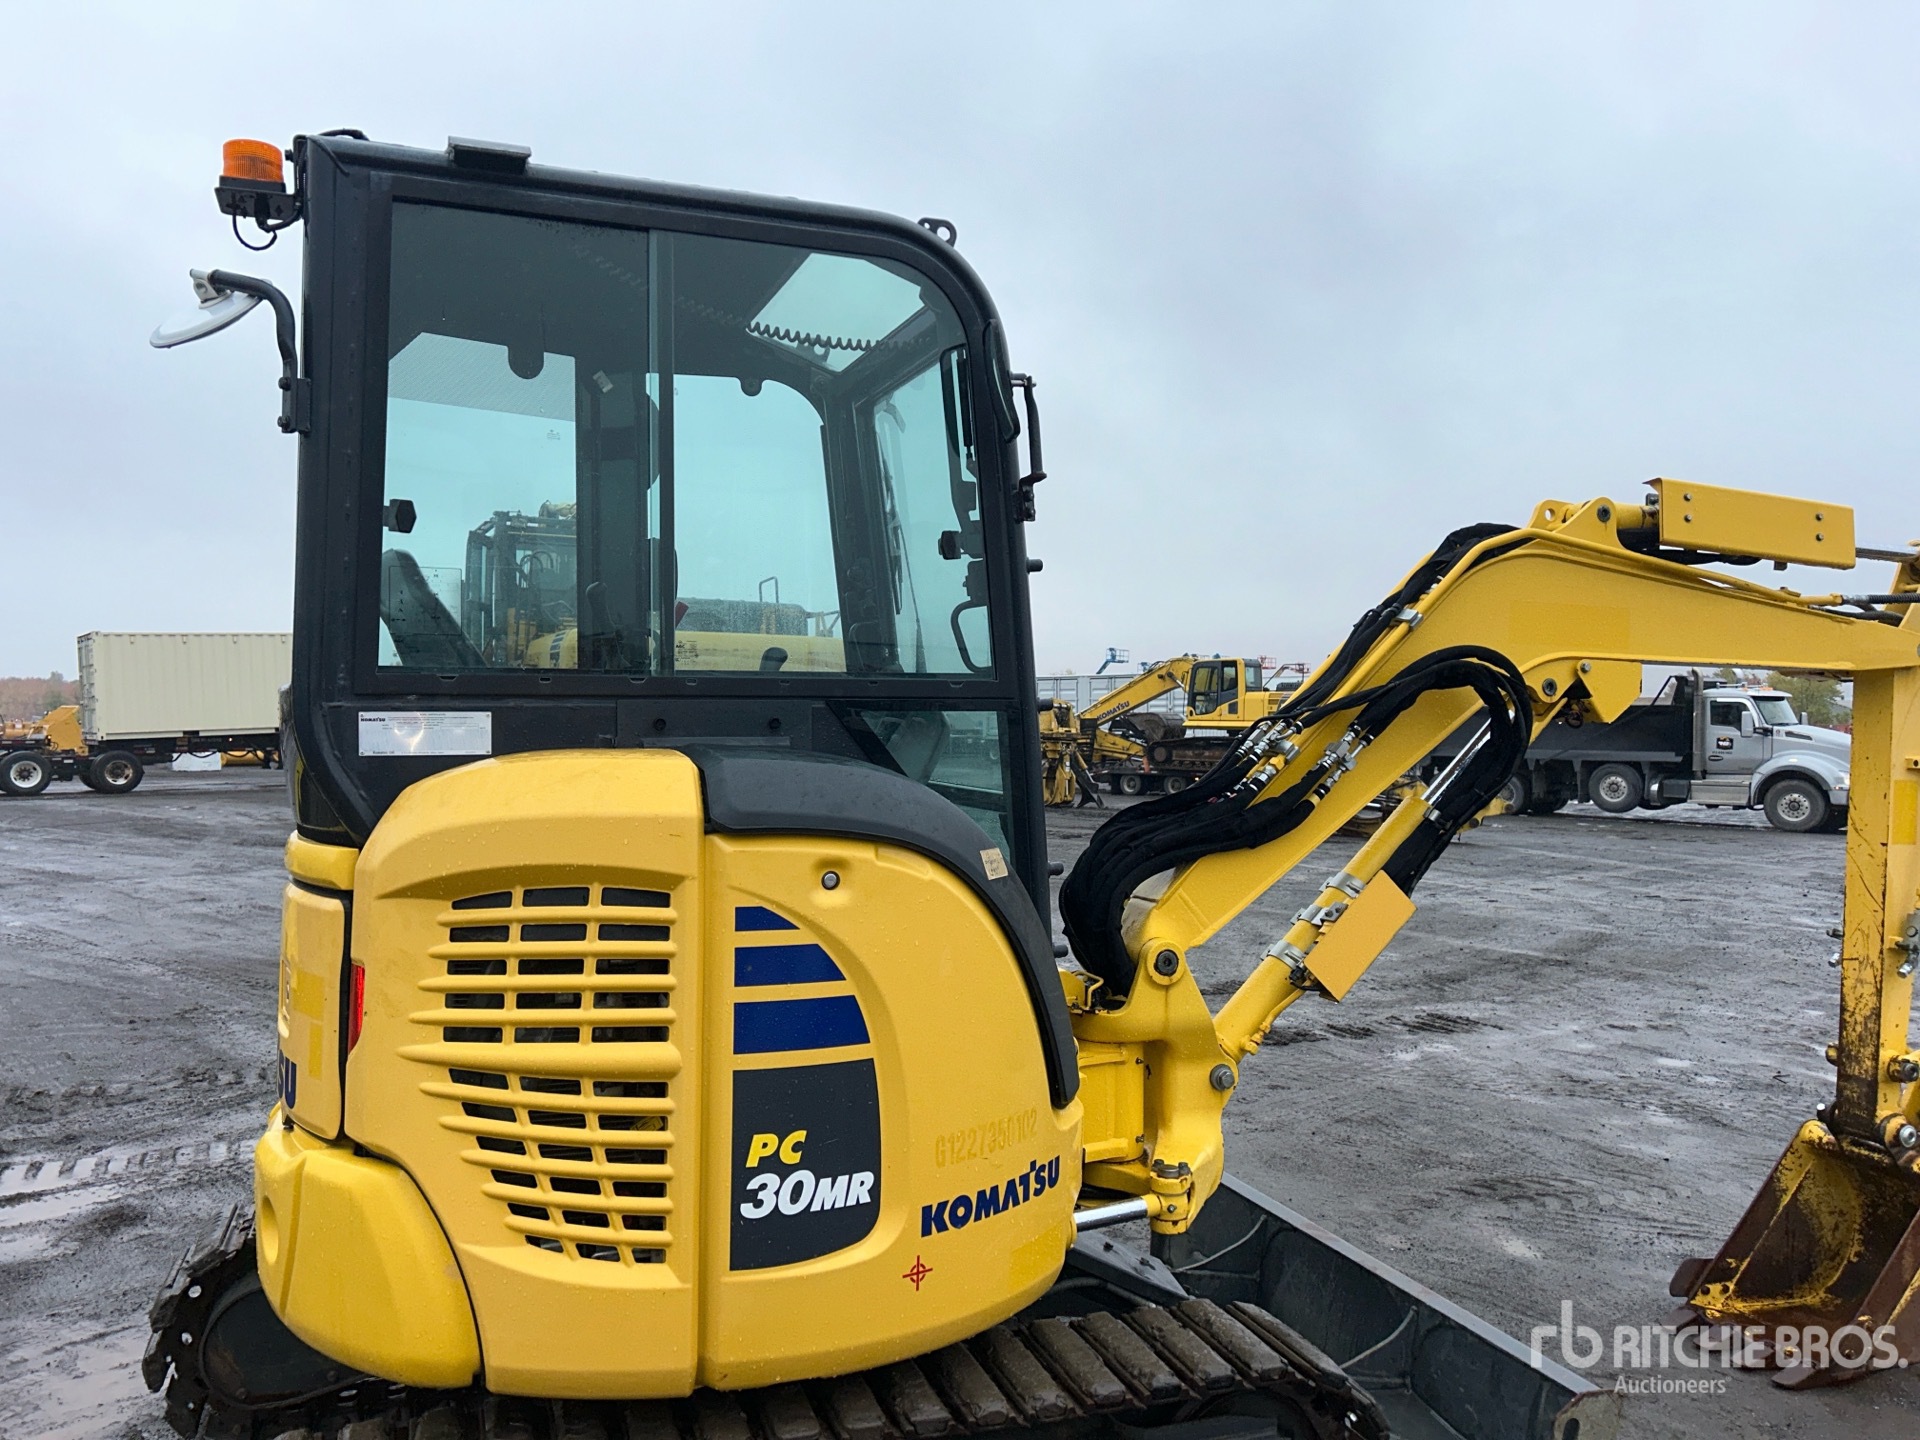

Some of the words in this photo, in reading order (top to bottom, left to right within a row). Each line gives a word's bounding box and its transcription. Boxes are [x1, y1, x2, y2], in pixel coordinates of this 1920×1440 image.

[1096, 701, 1130, 721] KOMATSU
[745, 1129, 807, 1168] PC
[740, 1169, 875, 1220] 30MR
[921, 1155, 1061, 1238] KOMATSU
